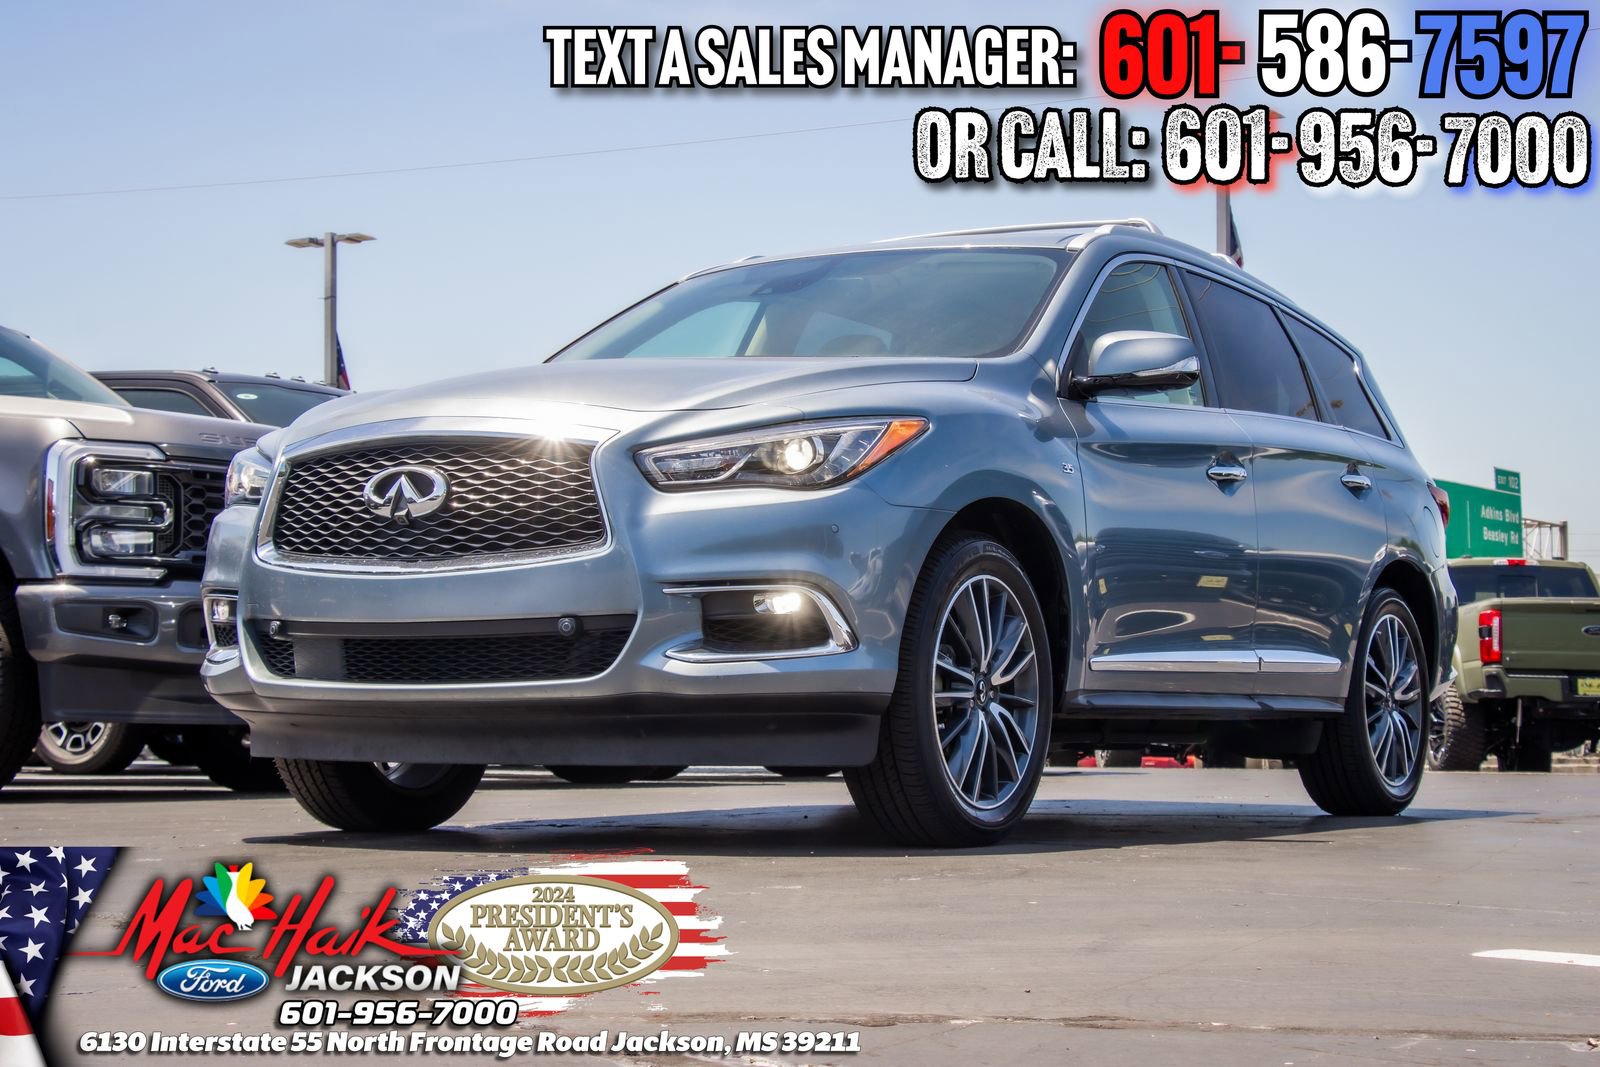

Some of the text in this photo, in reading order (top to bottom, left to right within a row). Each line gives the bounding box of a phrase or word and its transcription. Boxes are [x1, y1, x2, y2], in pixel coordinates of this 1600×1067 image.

[1481, 504, 1519, 524] Adkins Blvd
[1483, 526, 1519, 546] Beasley Rd
